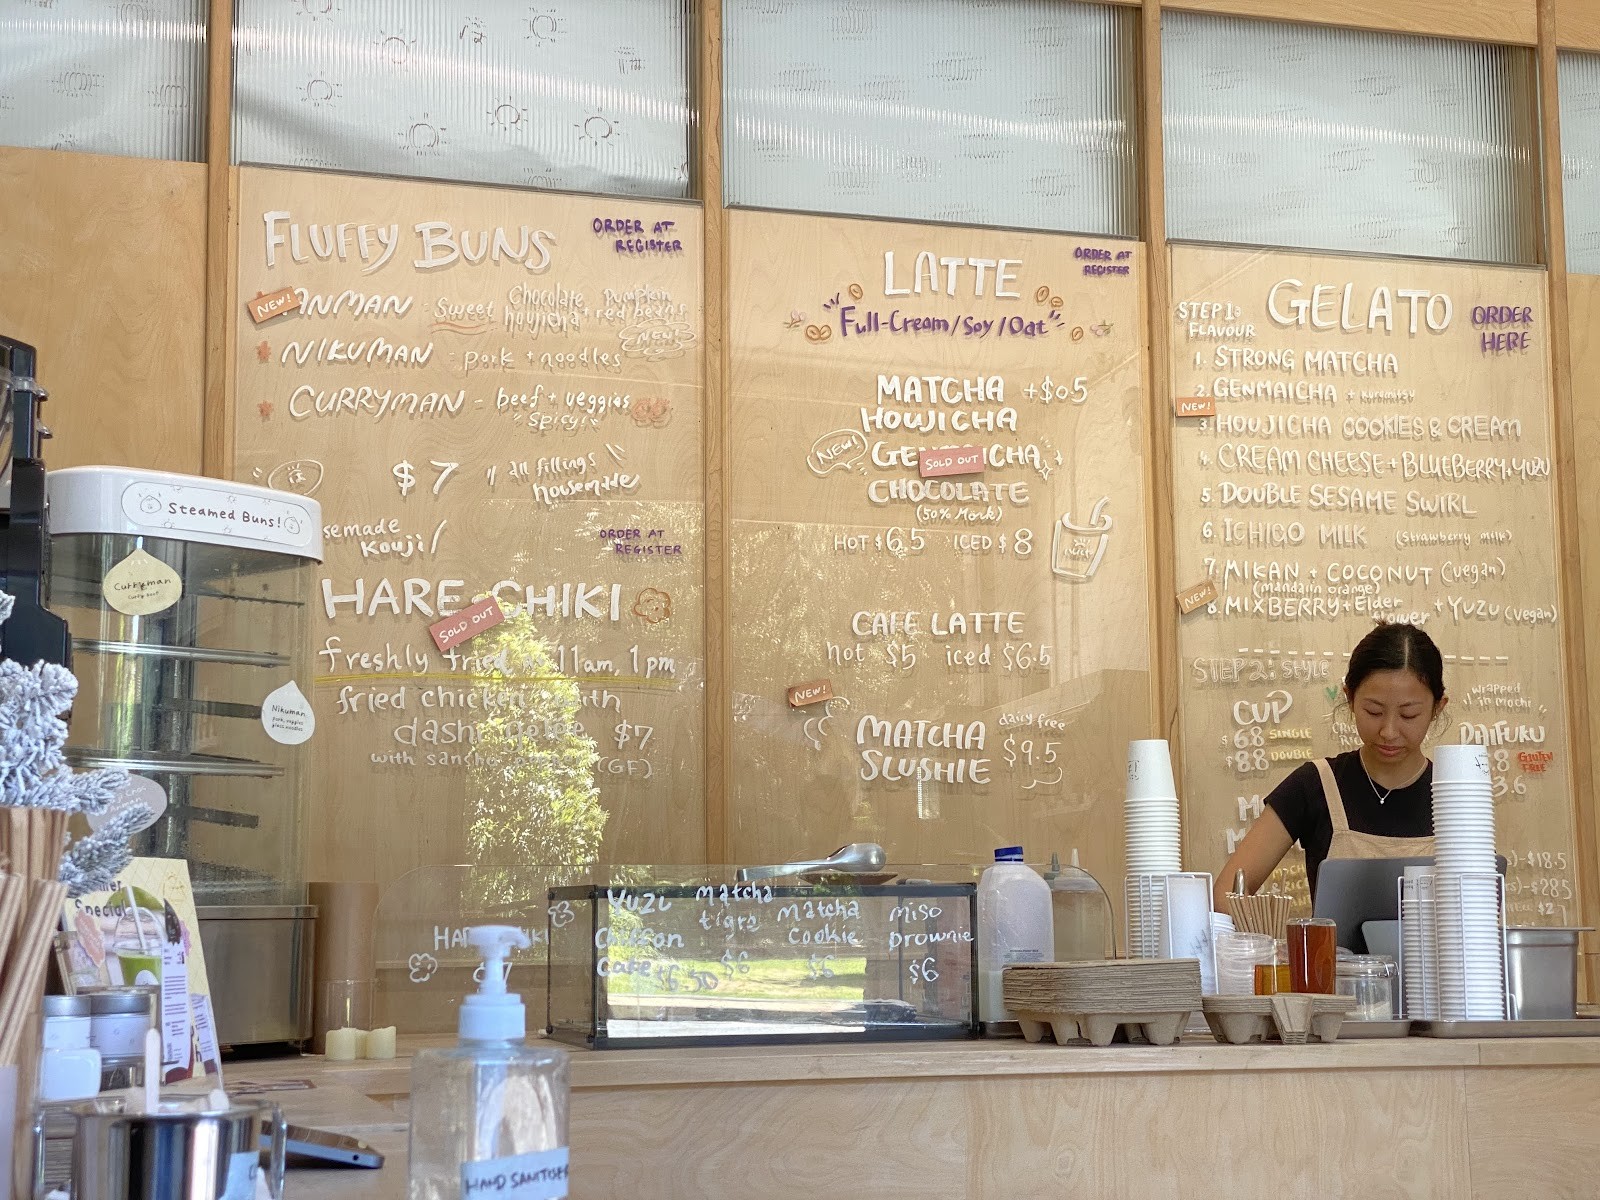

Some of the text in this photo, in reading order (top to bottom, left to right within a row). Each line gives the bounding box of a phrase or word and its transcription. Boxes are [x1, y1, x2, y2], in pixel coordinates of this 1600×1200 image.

[592, 217, 676, 234] ORDER AT
[414, 221, 556, 270] BUNS
[615, 239, 683, 253] REGISTER
[1074, 247, 1133, 261] ORDER AT
[884, 250, 1023, 299] LATTE
[1083, 264, 1131, 276] REGISTER
[256, 293, 292, 317] NEW!
[434, 297, 494, 318] Sweet
[509, 281, 672, 308] Chocolate Pumpkin
[1268, 278, 1453, 335] GELATO
[596, 304, 626, 320] red
[633, 302, 687, 320] beans
[1178, 301, 1223, 320] STEP
[1471, 305, 1534, 325] ORDER
[1189, 322, 1256, 337] FLAVOUR
[1481, 331, 1532, 353] HERE
[281, 336, 621, 370] NIKUMAN pork noodles
[1215, 345, 1295, 369] STRONG
[1304, 350, 1399, 373] MATCHA
[289, 384, 631, 418] CURRYMAN beef veggies
[877, 375, 1005, 404] MATCHA
[1213, 376, 1338, 402] GENMAICHA
[1181, 401, 1211, 412] NEW!
[1216, 414, 1332, 435] HOUJICHA
[1343, 415, 1424, 437] COOKIES
[1429, 417, 1443, 437] &
[1447, 415, 1522, 438] CREAM
[815, 435, 859, 464] NEW!
[871, 441, 1041, 468] GEICHA
[924, 454, 979, 471] SOLD OUT
[1218, 443, 1301, 471] CREAM
[1307, 449, 1385, 474] CHEESE
[508, 452, 597, 478] all fillings
[532, 472, 641, 504] housemade
[867, 478, 1030, 503] CHOCOLATE
[1218, 481, 1301, 504] DOUBLE
[1309, 483, 1397, 510] SESAME
[1406, 490, 1478, 514] SWIRL
[168, 501, 282, 528] Steamed Buns!
[916, 504, 951, 522] (50%
[323, 518, 400, 539] semade
[600, 529, 666, 540] ORDER AT
[1223, 517, 1306, 544] ICHIGO
[1319, 523, 1368, 545] MILK
[614, 543, 682, 555] REGISTER
[833, 534, 869, 551] HOT
[953, 534, 993, 550] ICED
[1224, 559, 1299, 590] MIKAN
[1327, 562, 1433, 585] COCONUT
[1441, 557, 1506, 583] (vegan)
[321, 577, 622, 622] HARE CHIKI
[1184, 586, 1211, 609] NEW!
[1328, 581, 1380, 596] orange)
[1355, 595, 1403, 612] Elder
[1447, 595, 1500, 621] YUZU
[1504, 604, 1558, 623] (vegan)
[438, 605, 495, 644] SOLD OUT
[852, 611, 1026, 636] CAFE LATTE
[318, 636, 429, 675] freshly
[826, 641, 1053, 672] hot $5 iced $6.5
[1193, 657, 1247, 683] STEP
[336, 686, 406, 715] fried
[421, 686, 526, 712] chicken
[794, 684, 827, 702] NEW!
[1471, 682, 1521, 695] wrapped
[1477, 696, 1492, 707] in
[271, 704, 306, 717] Nikuman
[1233, 689, 1294, 726] CUP
[613, 719, 654, 750] $7
[857, 714, 986, 750] MATCHA
[998, 712, 1066, 731] dairy free
[1458, 720, 1546, 747] DAIFUKU
[1003, 734, 1063, 767] $9.5
[370, 750, 416, 766] with
[597, 756, 653, 779] (GF)
[860, 750, 992, 784] SLUSHIE
[909, 957, 940, 984] $6
[465, 1172, 506, 1194] HAND
